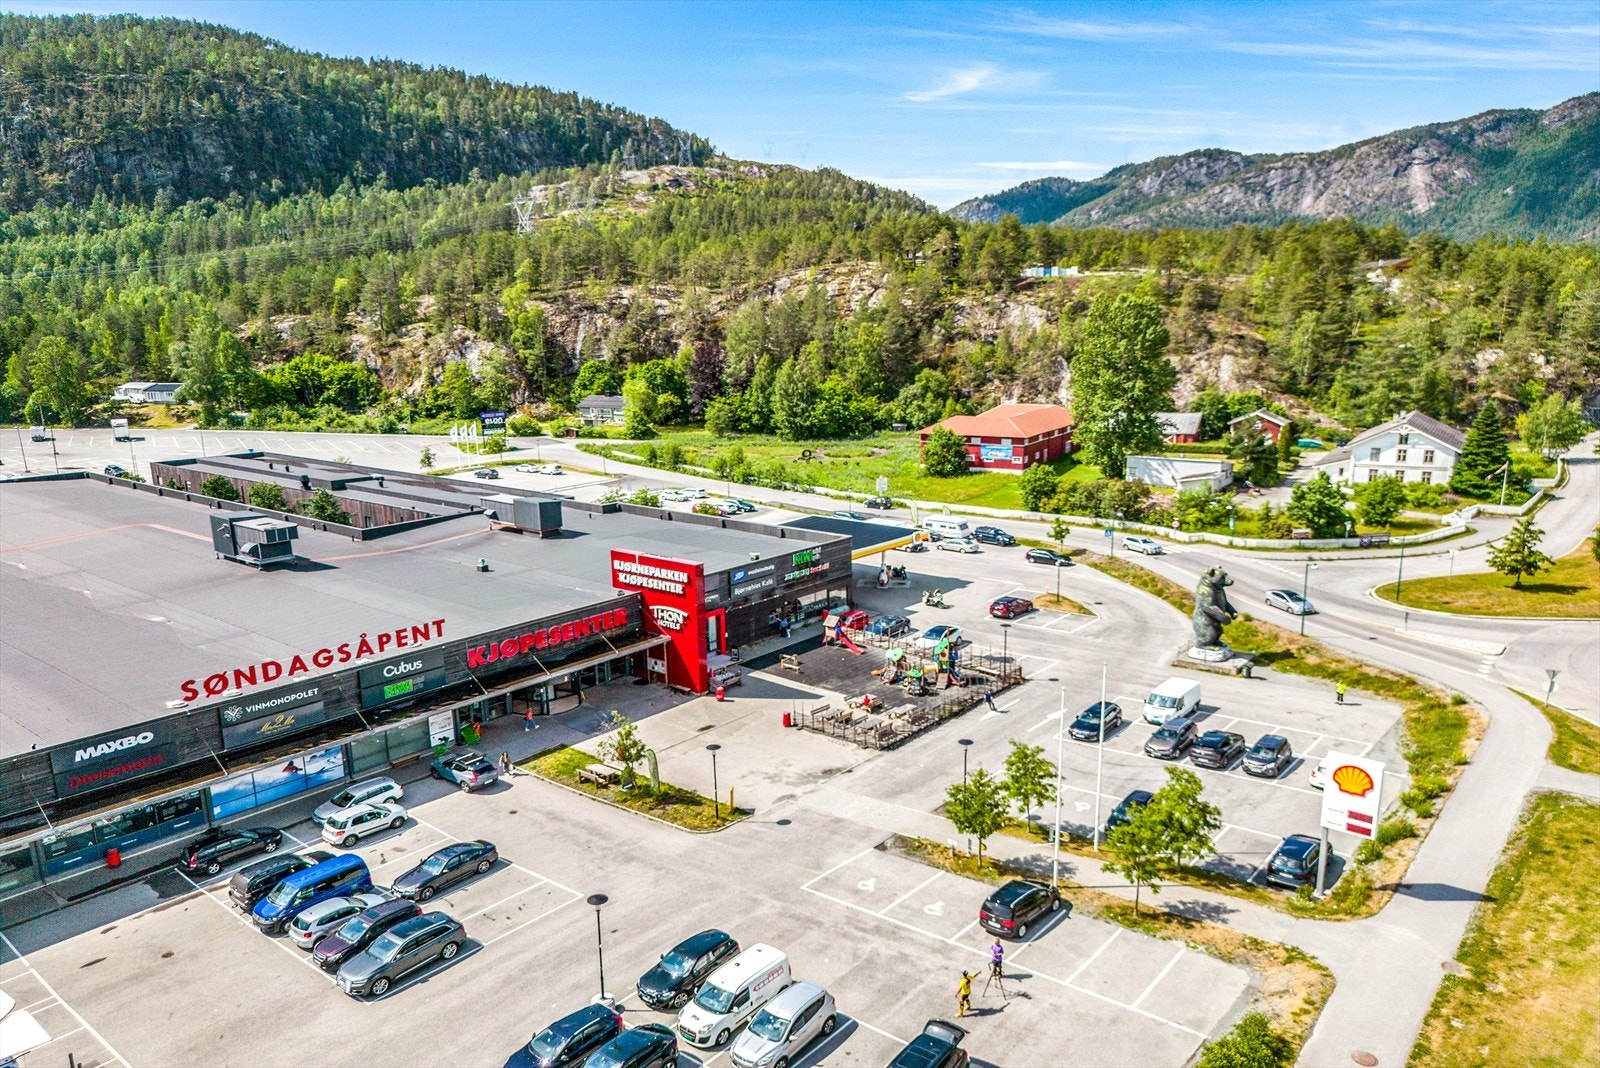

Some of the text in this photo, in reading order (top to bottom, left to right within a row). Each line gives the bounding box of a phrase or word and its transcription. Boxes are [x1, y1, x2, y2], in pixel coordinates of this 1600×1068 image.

[613, 560, 688, 583] BJØRNEPARKEN
[618, 572, 684, 594] KJØPESENTER
[649, 605, 688, 624] THON
[657, 619, 681, 630] HOTELS
[466, 607, 629, 669] KJØPESENTER
[180, 618, 446, 702] SØNDAGSÅPENT
[383, 660, 423, 677] Cubus
[245, 688, 319, 713] VINMONOPOLET
[75, 731, 154, 763] MAXBO
